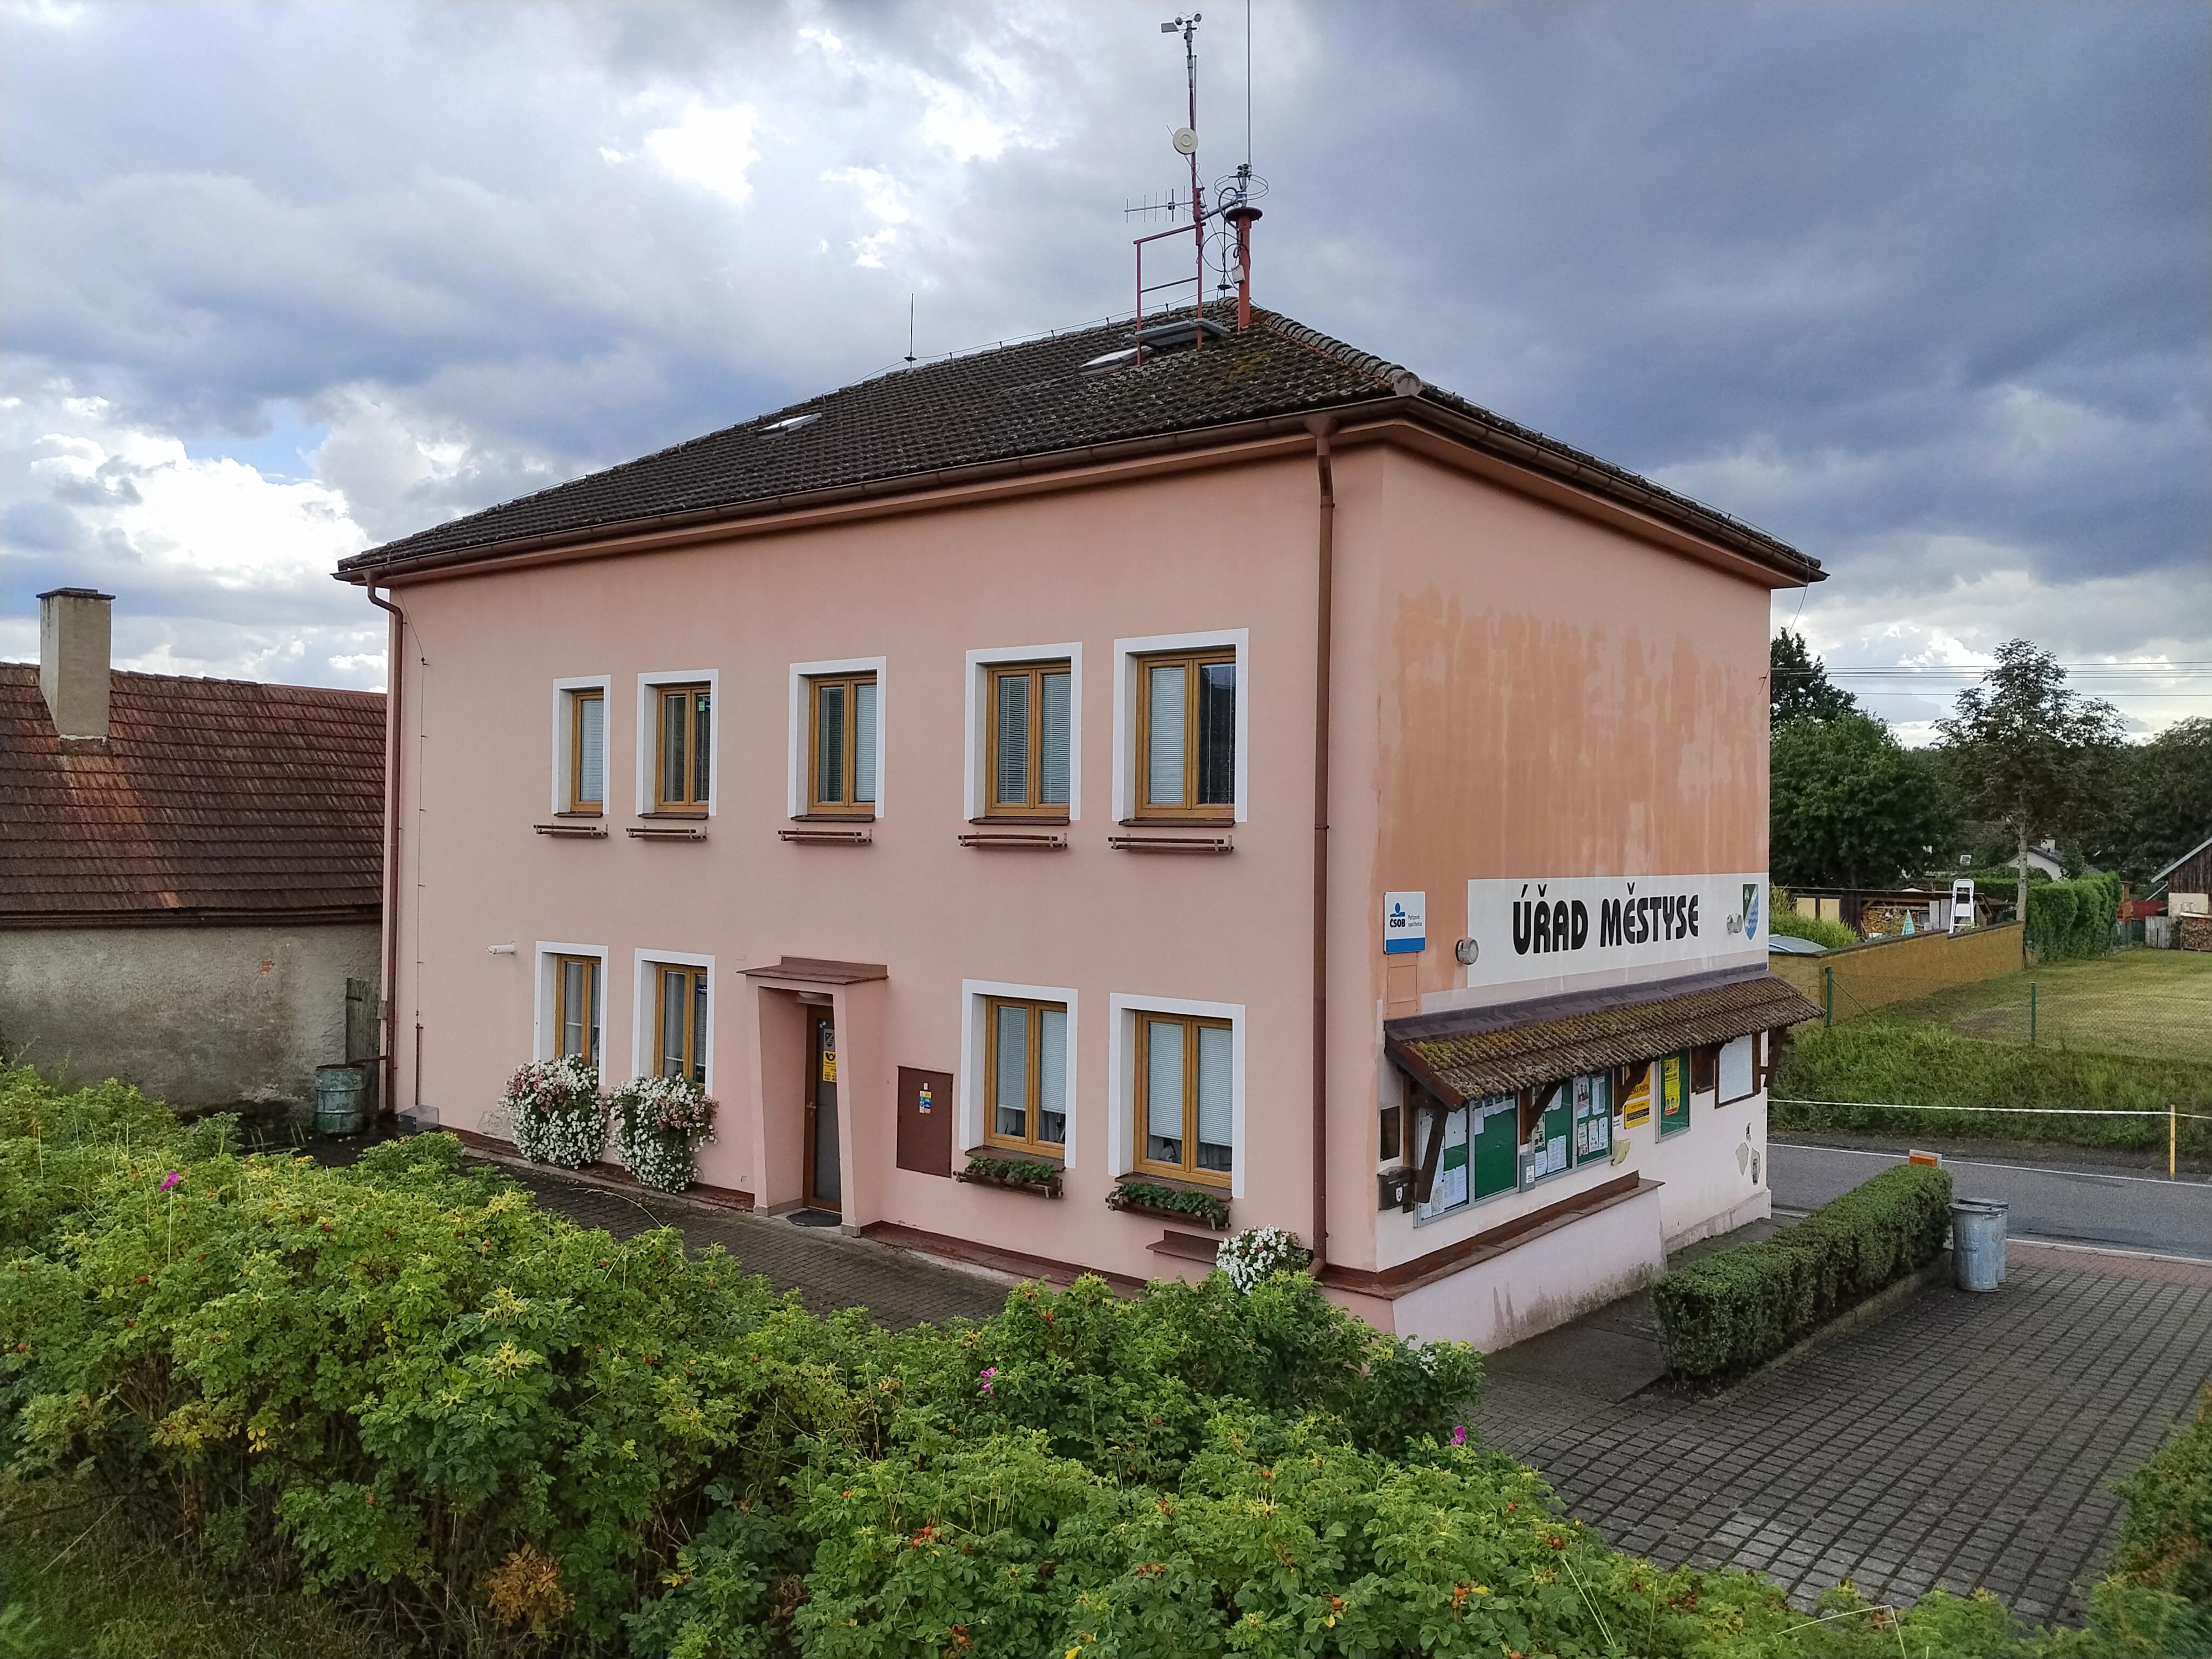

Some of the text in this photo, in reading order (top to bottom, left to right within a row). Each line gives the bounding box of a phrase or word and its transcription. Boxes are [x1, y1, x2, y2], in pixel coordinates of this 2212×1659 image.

[1390, 918, 1406, 927] ČSOB
[1512, 881, 1699, 955] ÚŘAD MĚSTYSE
